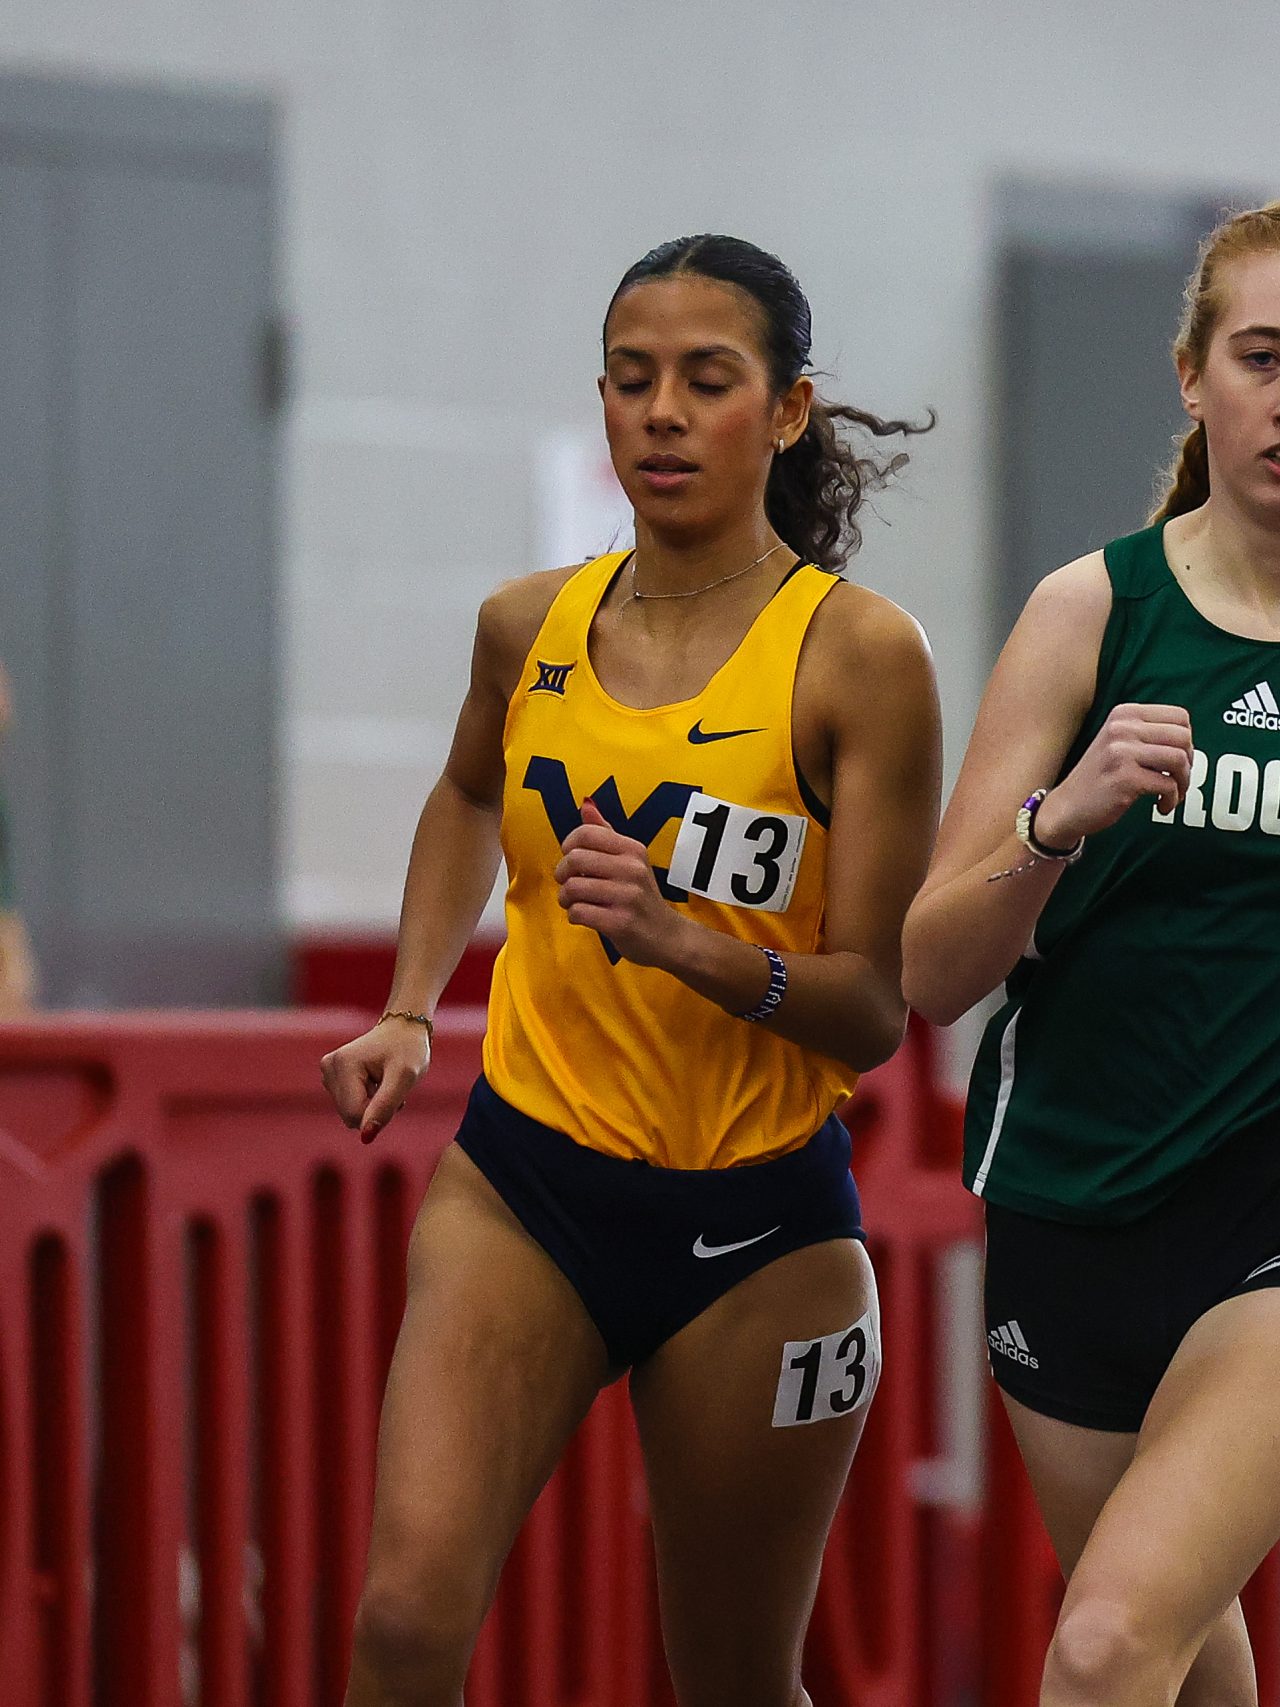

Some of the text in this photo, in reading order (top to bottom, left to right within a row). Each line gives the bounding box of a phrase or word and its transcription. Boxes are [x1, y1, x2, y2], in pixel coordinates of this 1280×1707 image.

[528, 659, 573, 697] XII
[691, 803, 790, 905] 13
[790, 1326, 866, 1422] 13
[987, 1335, 1039, 1369] adidas
